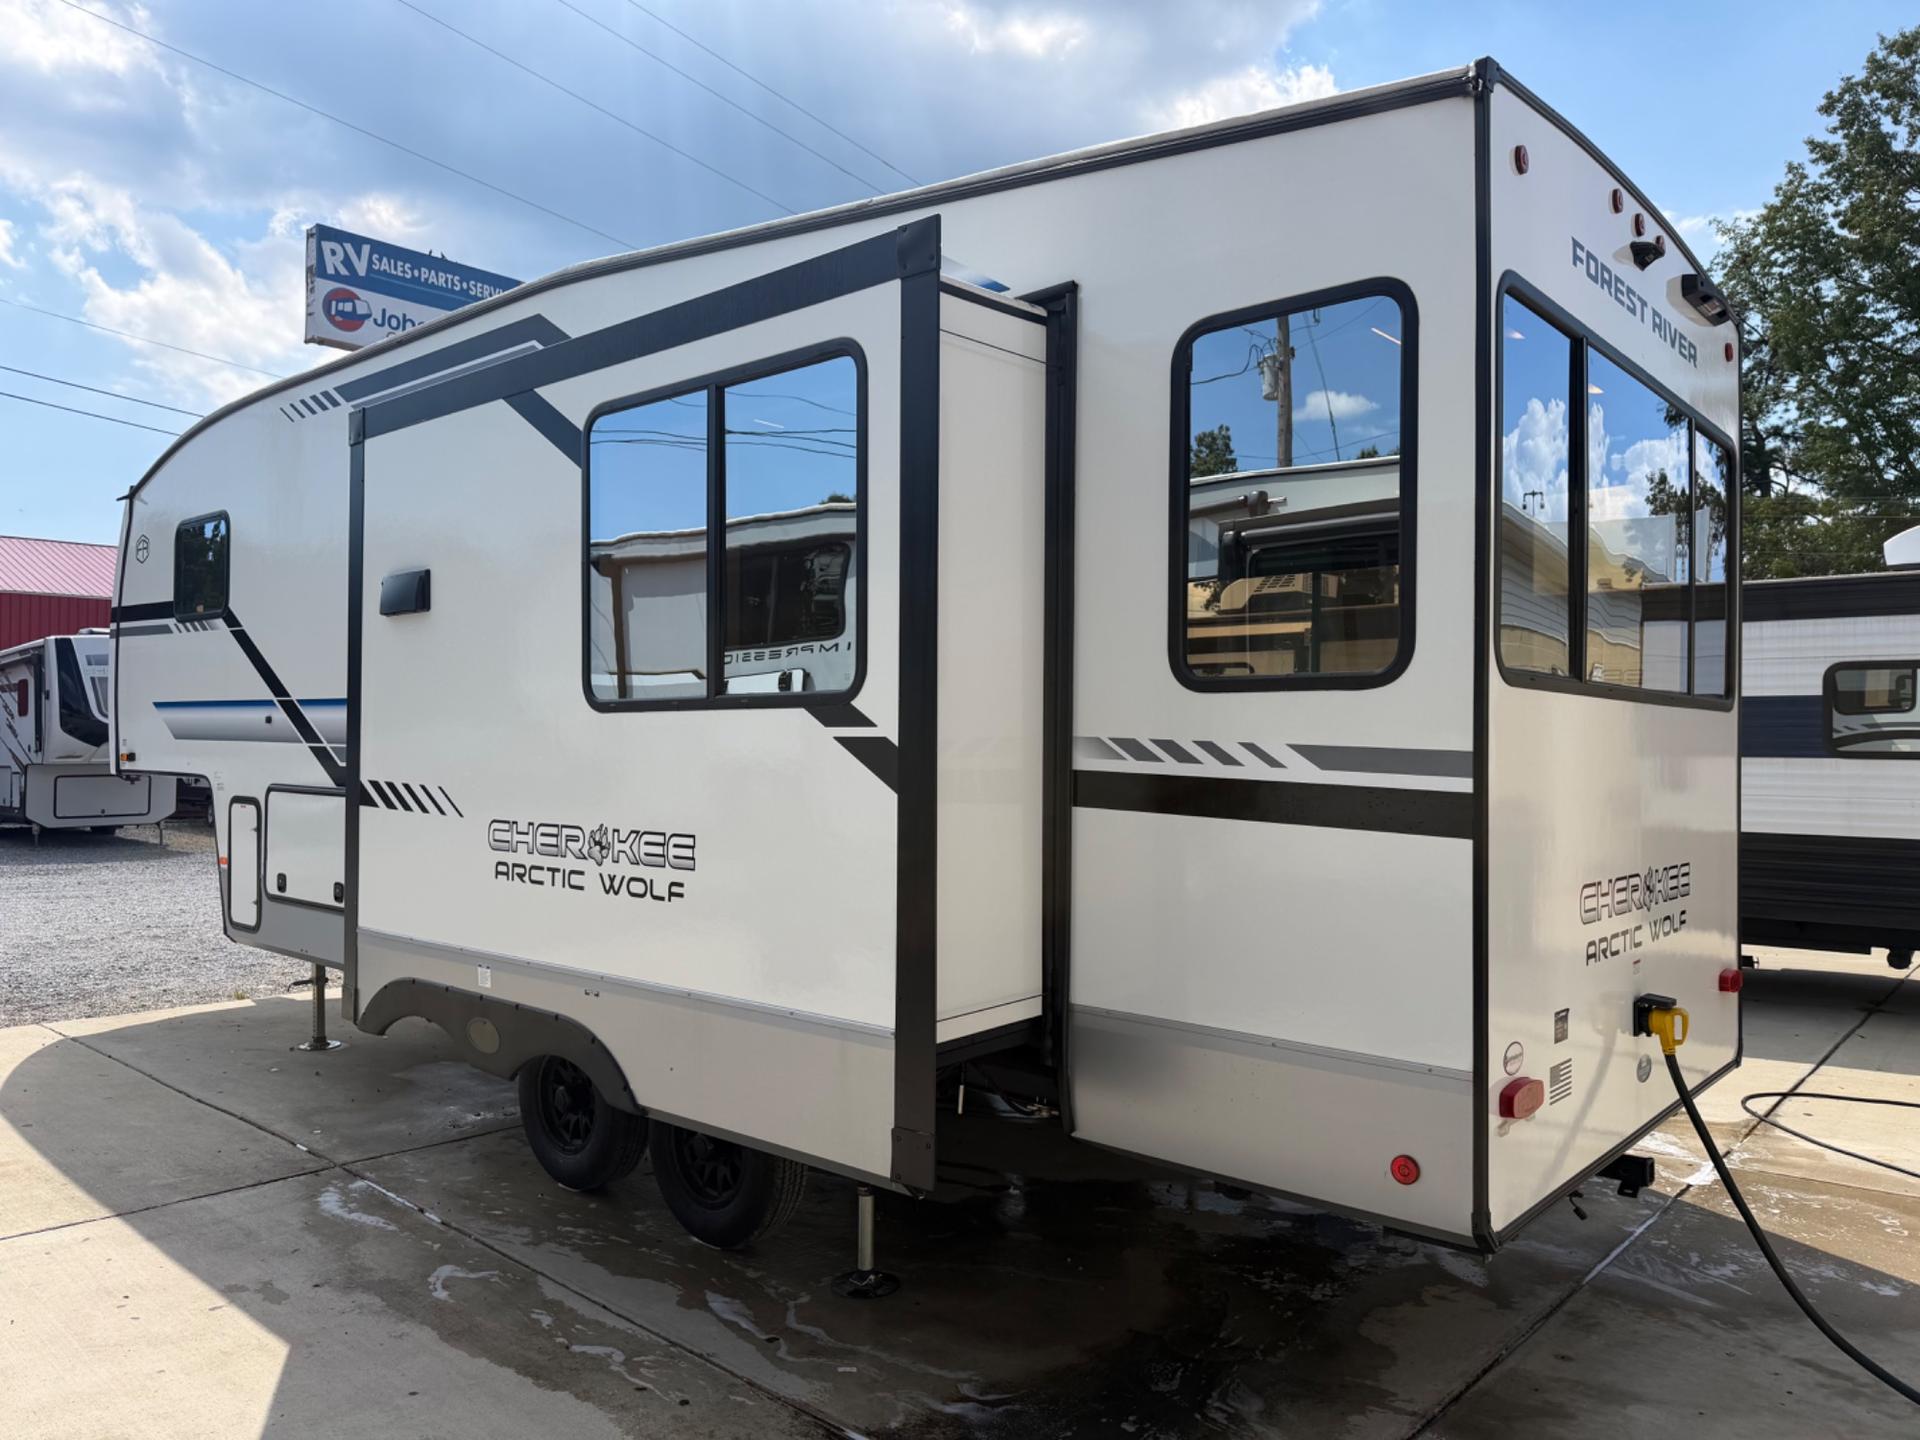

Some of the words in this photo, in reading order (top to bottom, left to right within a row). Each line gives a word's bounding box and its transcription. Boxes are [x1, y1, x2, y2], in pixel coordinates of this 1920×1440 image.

[321, 240, 371, 277] RV
[372, 254, 412, 279] SALES
[421, 268, 461, 291] PARTS
[373, 308, 425, 331] Joh
[1571, 236, 1648, 324] FOREST
[1652, 307, 1698, 368] RIVER
[494, 861, 585, 891] ARCTIC
[599, 872, 685, 903] WOLF
[1586, 924, 1643, 967] ARCTIC
[1648, 909, 1687, 943] WOLF
